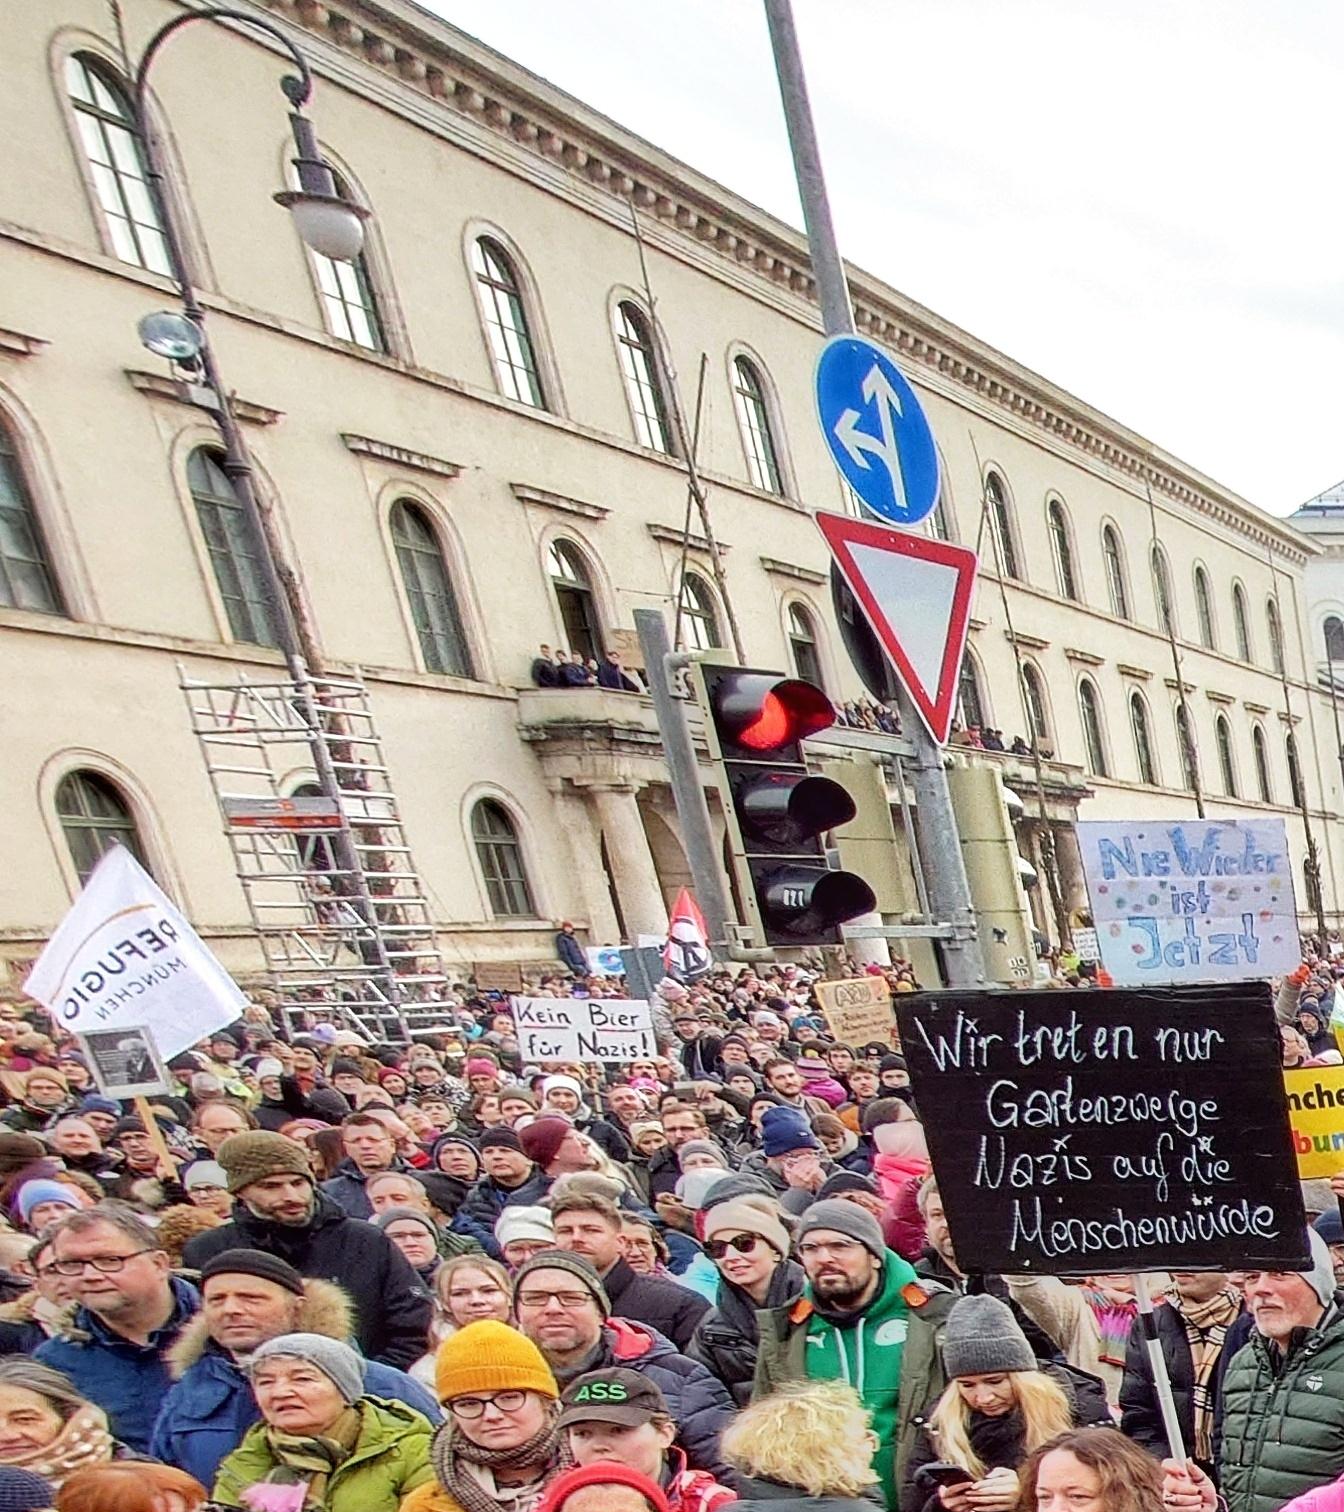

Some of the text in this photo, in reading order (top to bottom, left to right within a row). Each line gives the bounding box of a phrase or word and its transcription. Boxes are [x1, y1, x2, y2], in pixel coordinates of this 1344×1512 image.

[1097, 826, 1282, 880] Nie Wieder
[1170, 880, 1211, 914] ist
[1127, 913, 1260, 969] Jetzt
[517, 1003, 640, 1026] Kein Bier
[914, 1010, 1003, 1072] Wir
[1014, 1009, 1138, 1066] treten
[1155, 1026, 1224, 1062] nur
[527, 1031, 649, 1057] für Nazis!
[987, 1076, 1221, 1136] Gartenzwerge
[975, 1134, 1236, 1203] Nazis auf die
[1009, 1195, 1280, 1258] Menschenwürde
[573, 1383, 627, 1402] ASS
